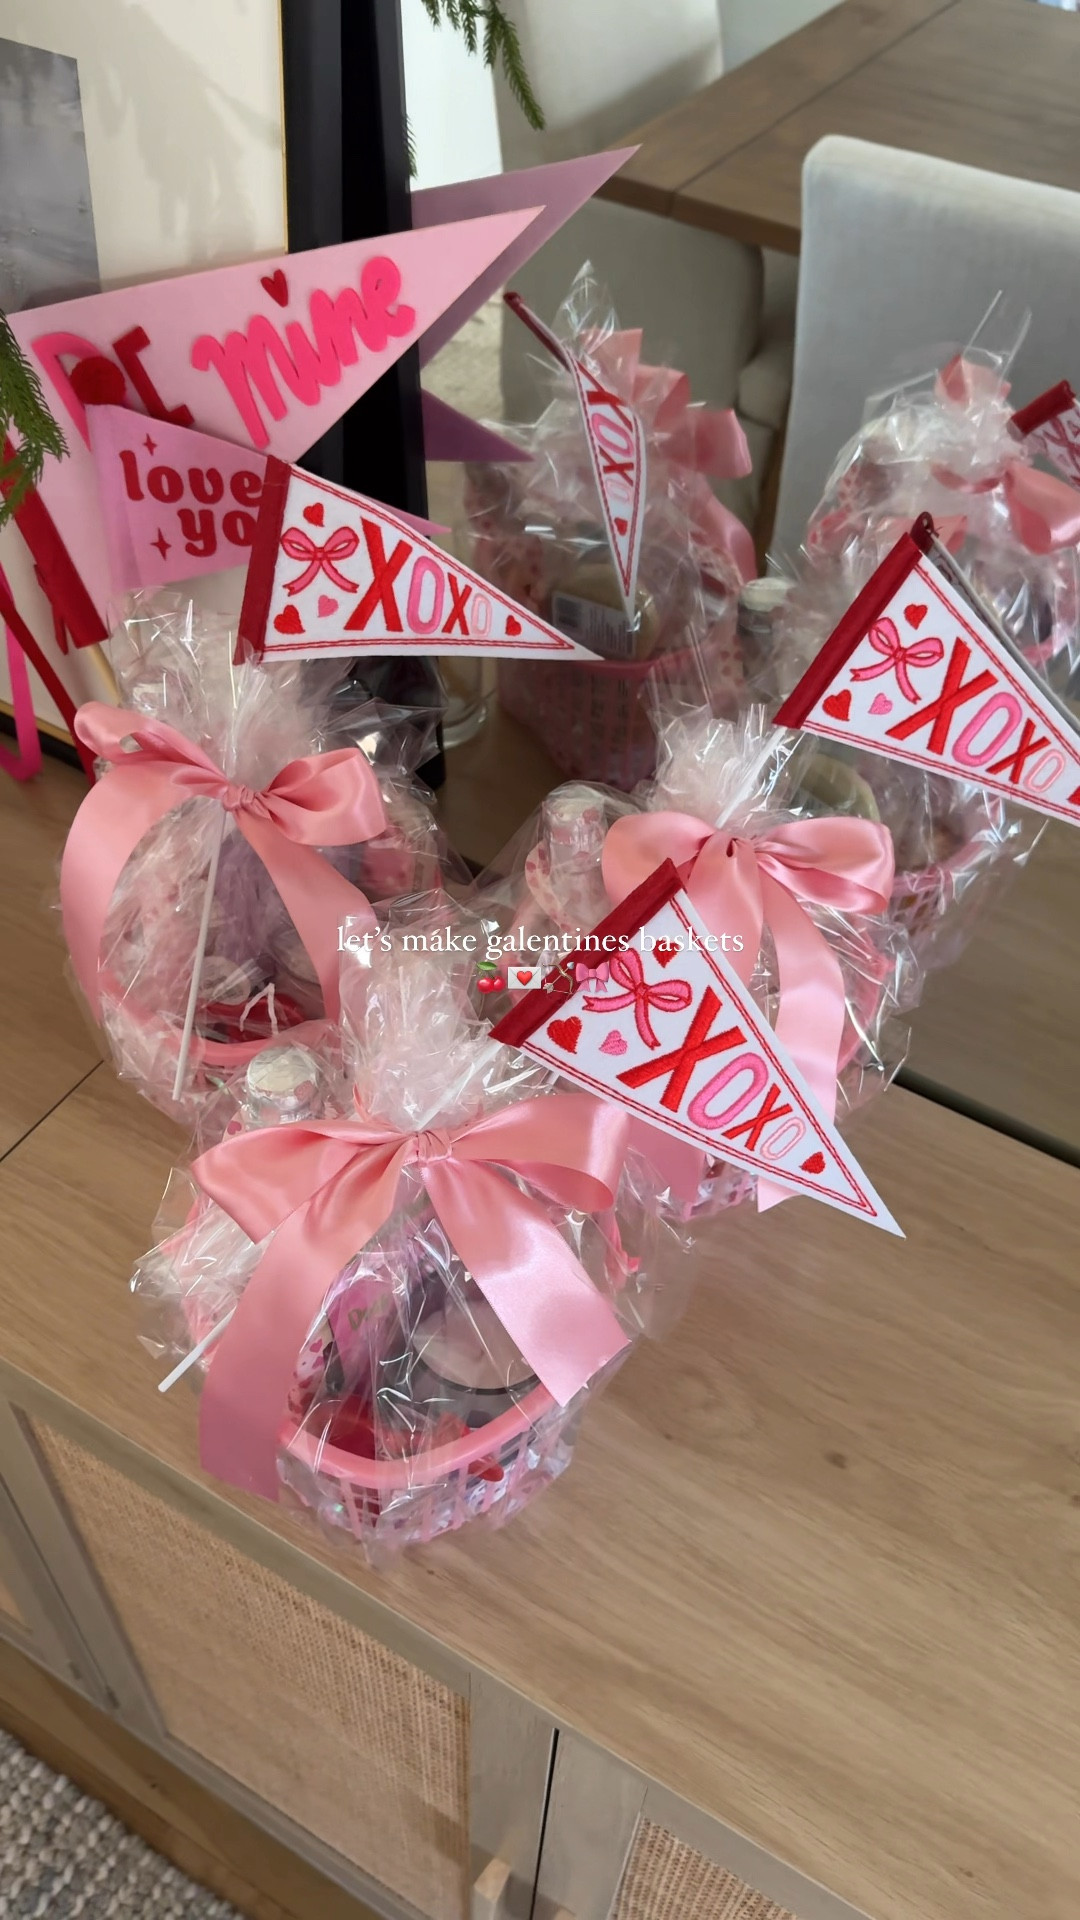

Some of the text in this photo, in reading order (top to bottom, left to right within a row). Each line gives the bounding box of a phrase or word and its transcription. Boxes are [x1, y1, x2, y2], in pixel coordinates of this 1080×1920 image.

[119, 450, 263, 507] love
[577, 361, 635, 504] XOXO
[177, 508, 257, 558] yo
[343, 516, 492, 635] XOXO
[885, 636, 1066, 793] XOXO
[616, 985, 807, 1160] XOXO
